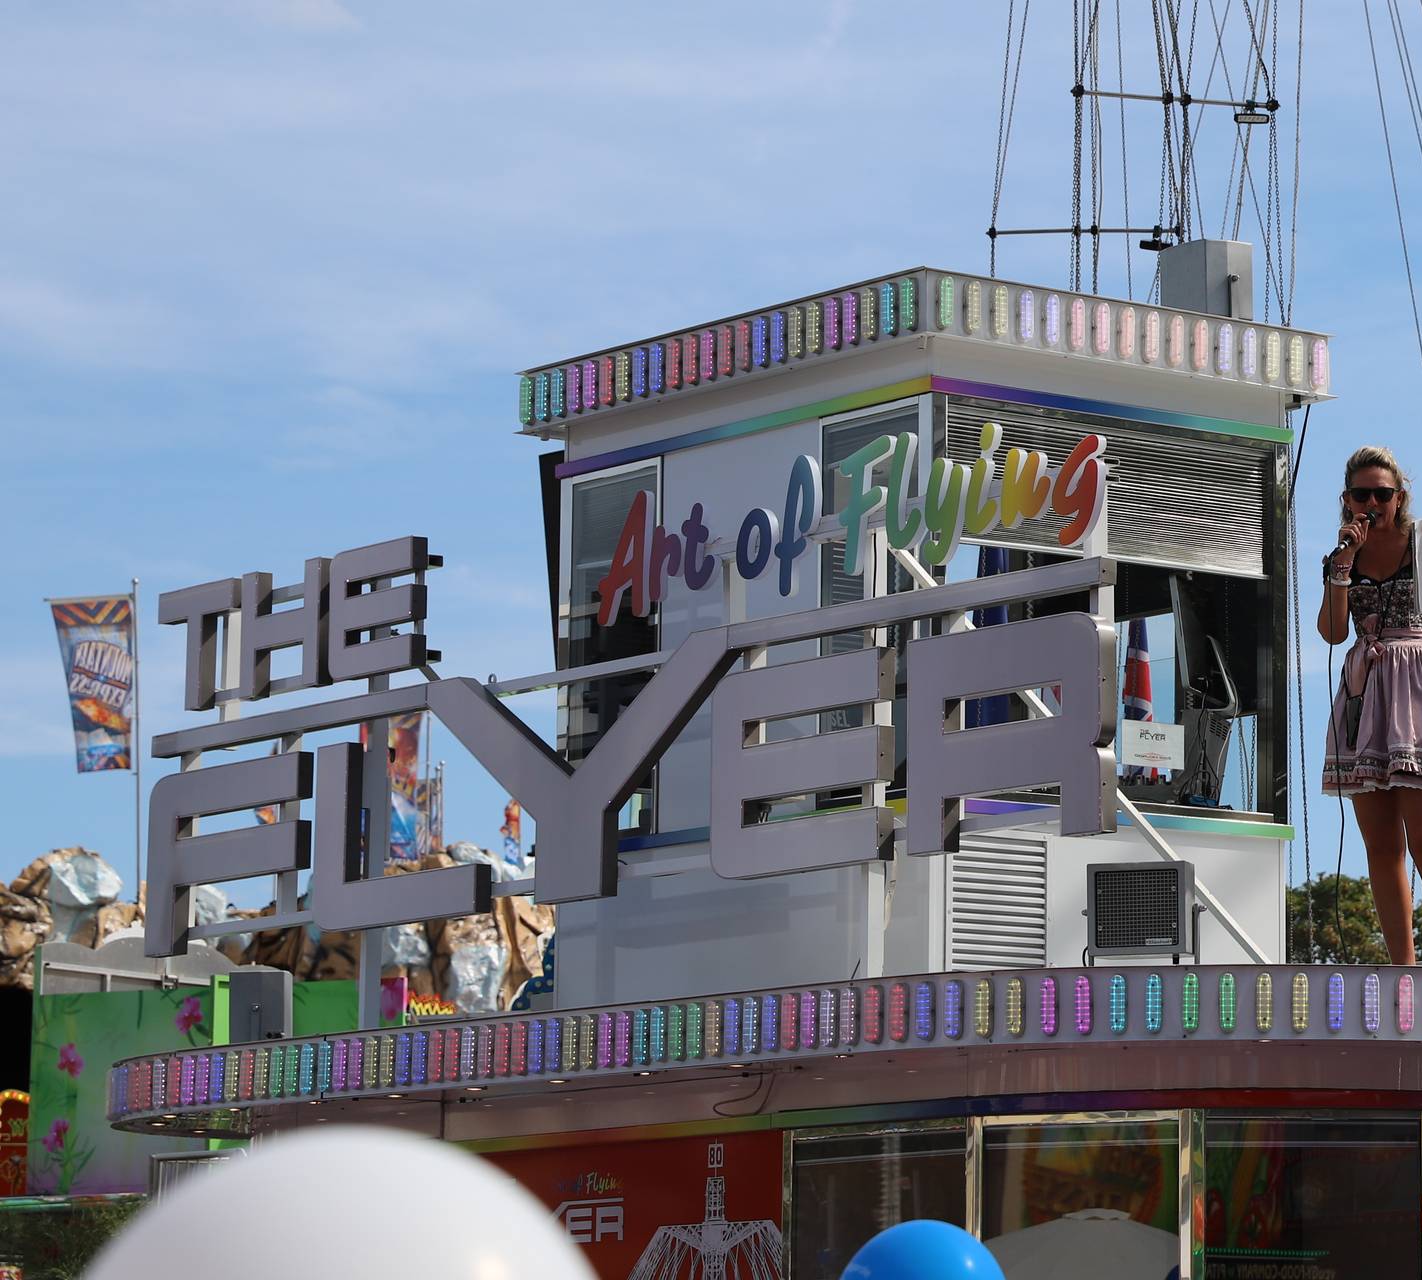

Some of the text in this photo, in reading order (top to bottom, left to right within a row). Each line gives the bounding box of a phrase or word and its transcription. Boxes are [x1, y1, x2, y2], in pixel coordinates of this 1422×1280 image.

[598, 423, 1106, 627] Art of Flying
[158, 536, 428, 711] THE
[144, 608, 1117, 958] FLYER
[1140, 732, 1165, 741] FLYER
[709, 1147, 722, 1166] 80
